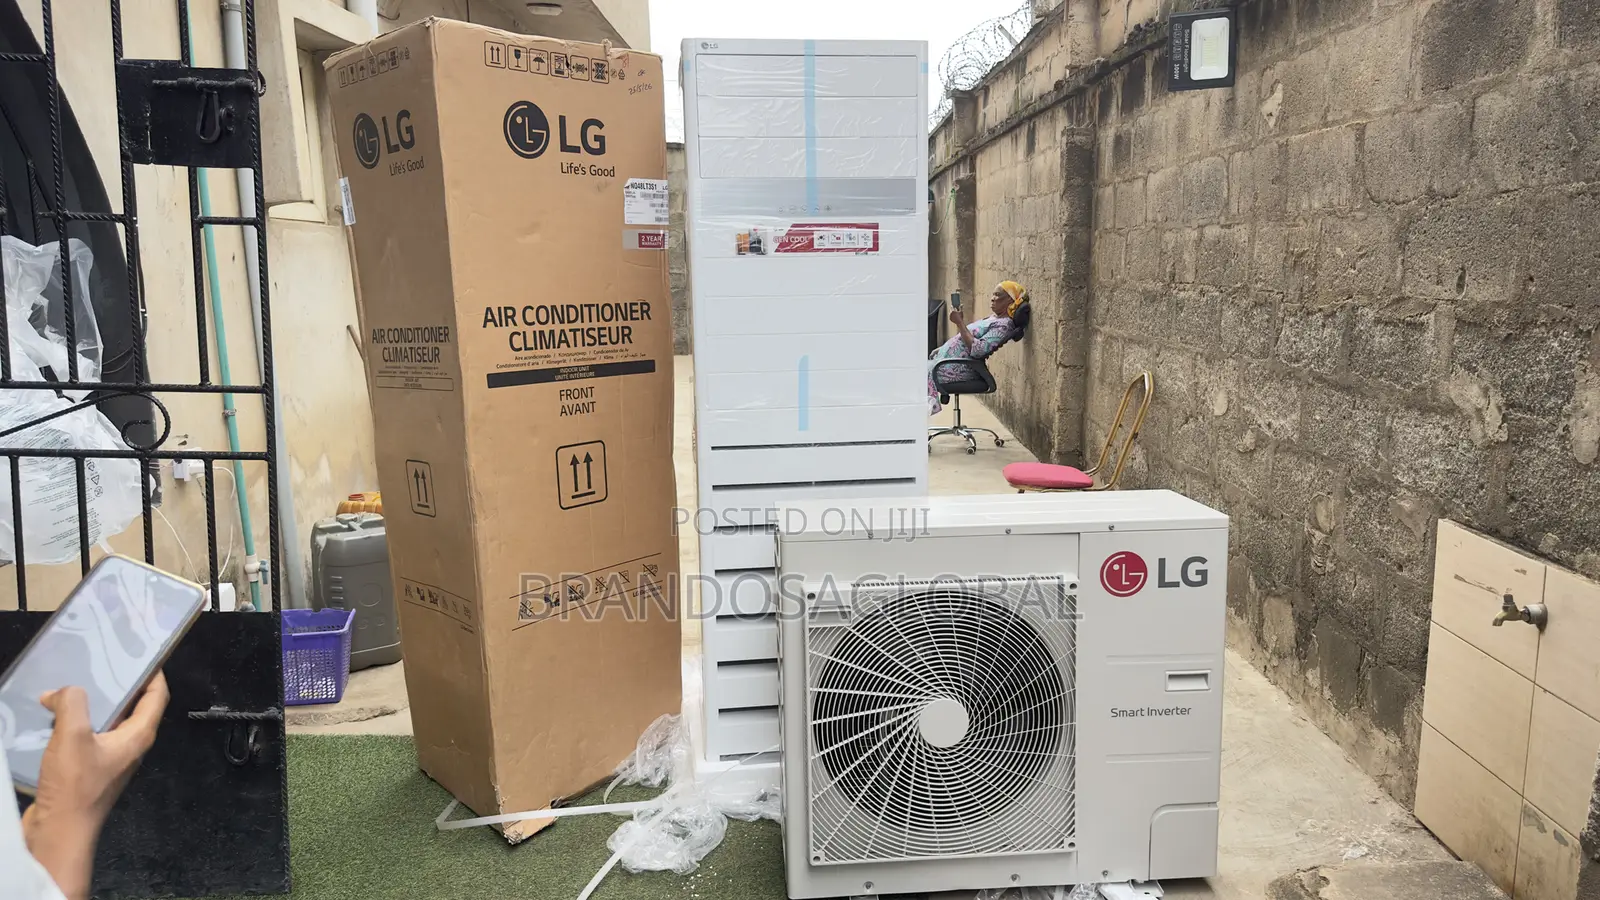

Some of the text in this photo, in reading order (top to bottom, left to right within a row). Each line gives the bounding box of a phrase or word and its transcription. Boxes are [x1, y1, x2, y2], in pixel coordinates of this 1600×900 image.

[382, 109, 416, 155] LG
[558, 114, 606, 156] LG
[389, 156, 425, 177] Life's Good
[560, 161, 615, 178] Life's Good
[773, 236, 789, 244] GEN
[482, 301, 652, 329] AIR CONDITIONER
[372, 326, 450, 344] AIR CONDITIONER
[508, 326, 633, 352] CLIMATISEUR
[382, 346, 441, 363] CLIMATISEUR
[559, 386, 595, 401] FRONT
[559, 401, 596, 417] AVANT
[1157, 555, 1209, 589] LG
[1110, 705, 1192, 718] Smart Inverter
